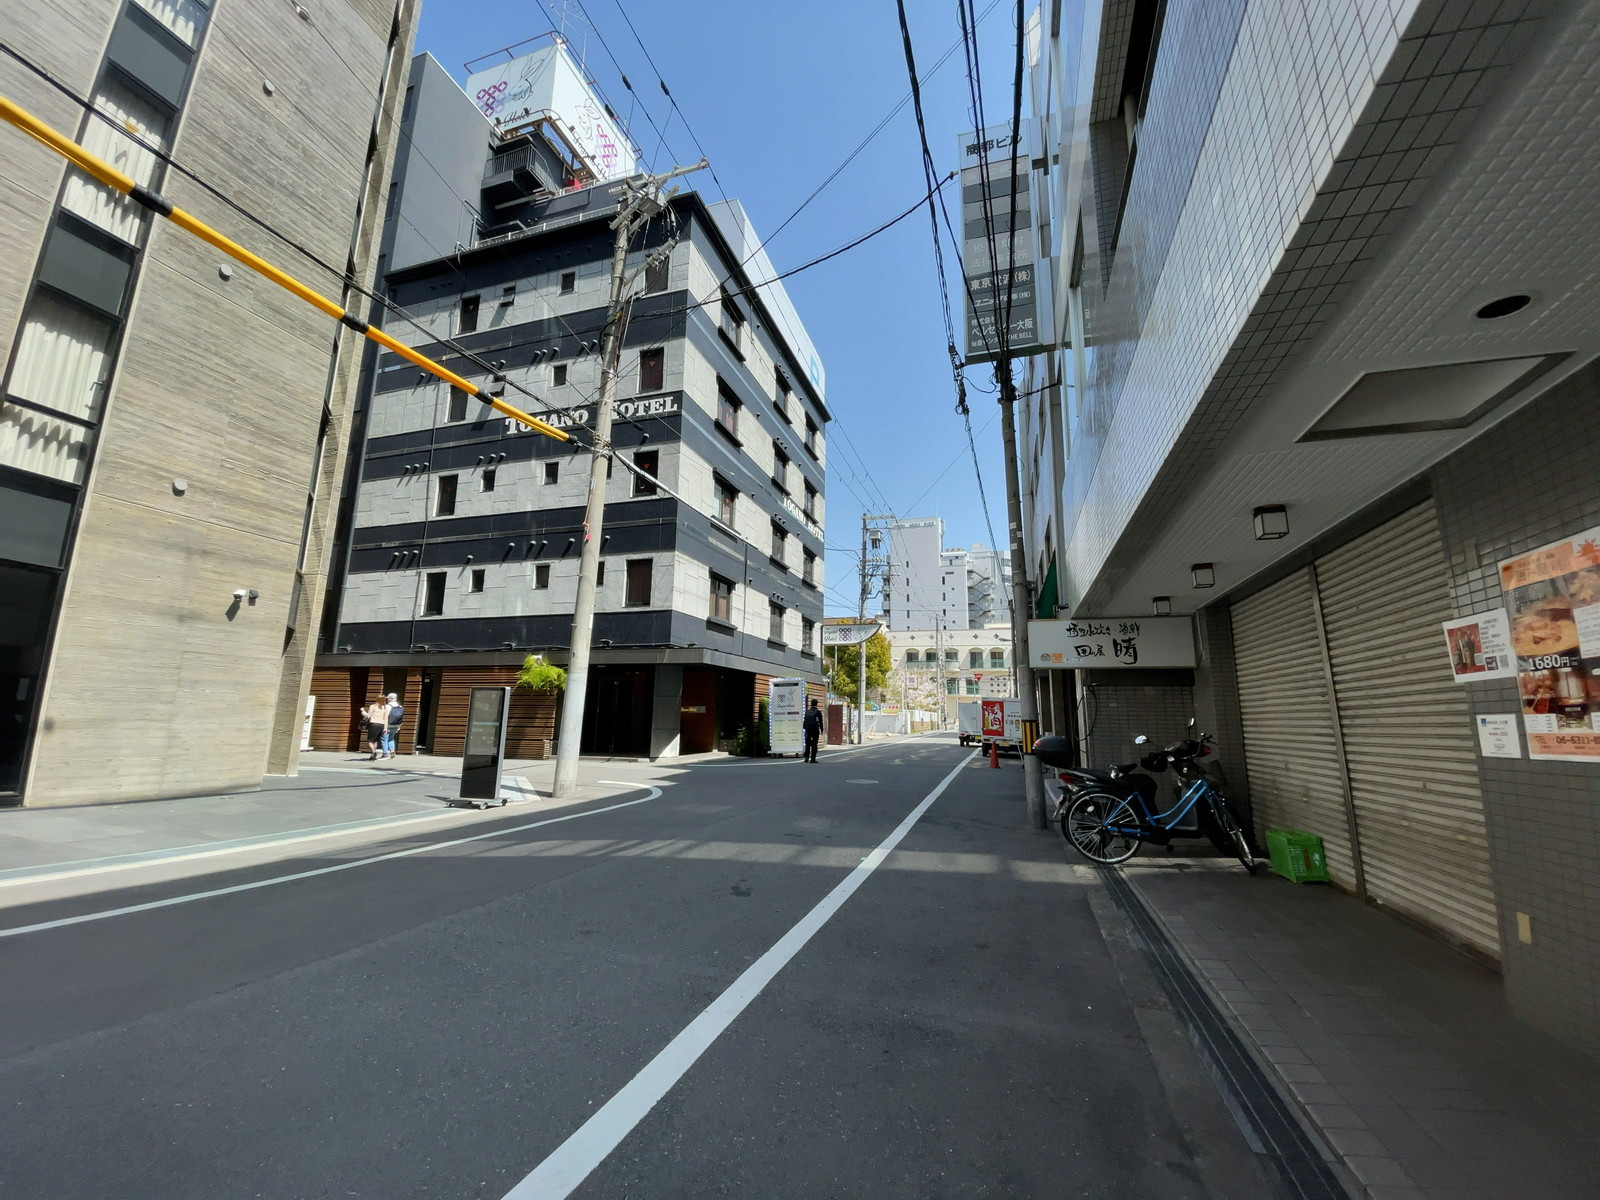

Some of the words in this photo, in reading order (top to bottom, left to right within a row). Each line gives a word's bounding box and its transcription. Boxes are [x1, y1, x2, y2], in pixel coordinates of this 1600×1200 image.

[972, 318, 1033, 336] ベルセー大阪
[1528, 654, 1570, 670] 1680円
